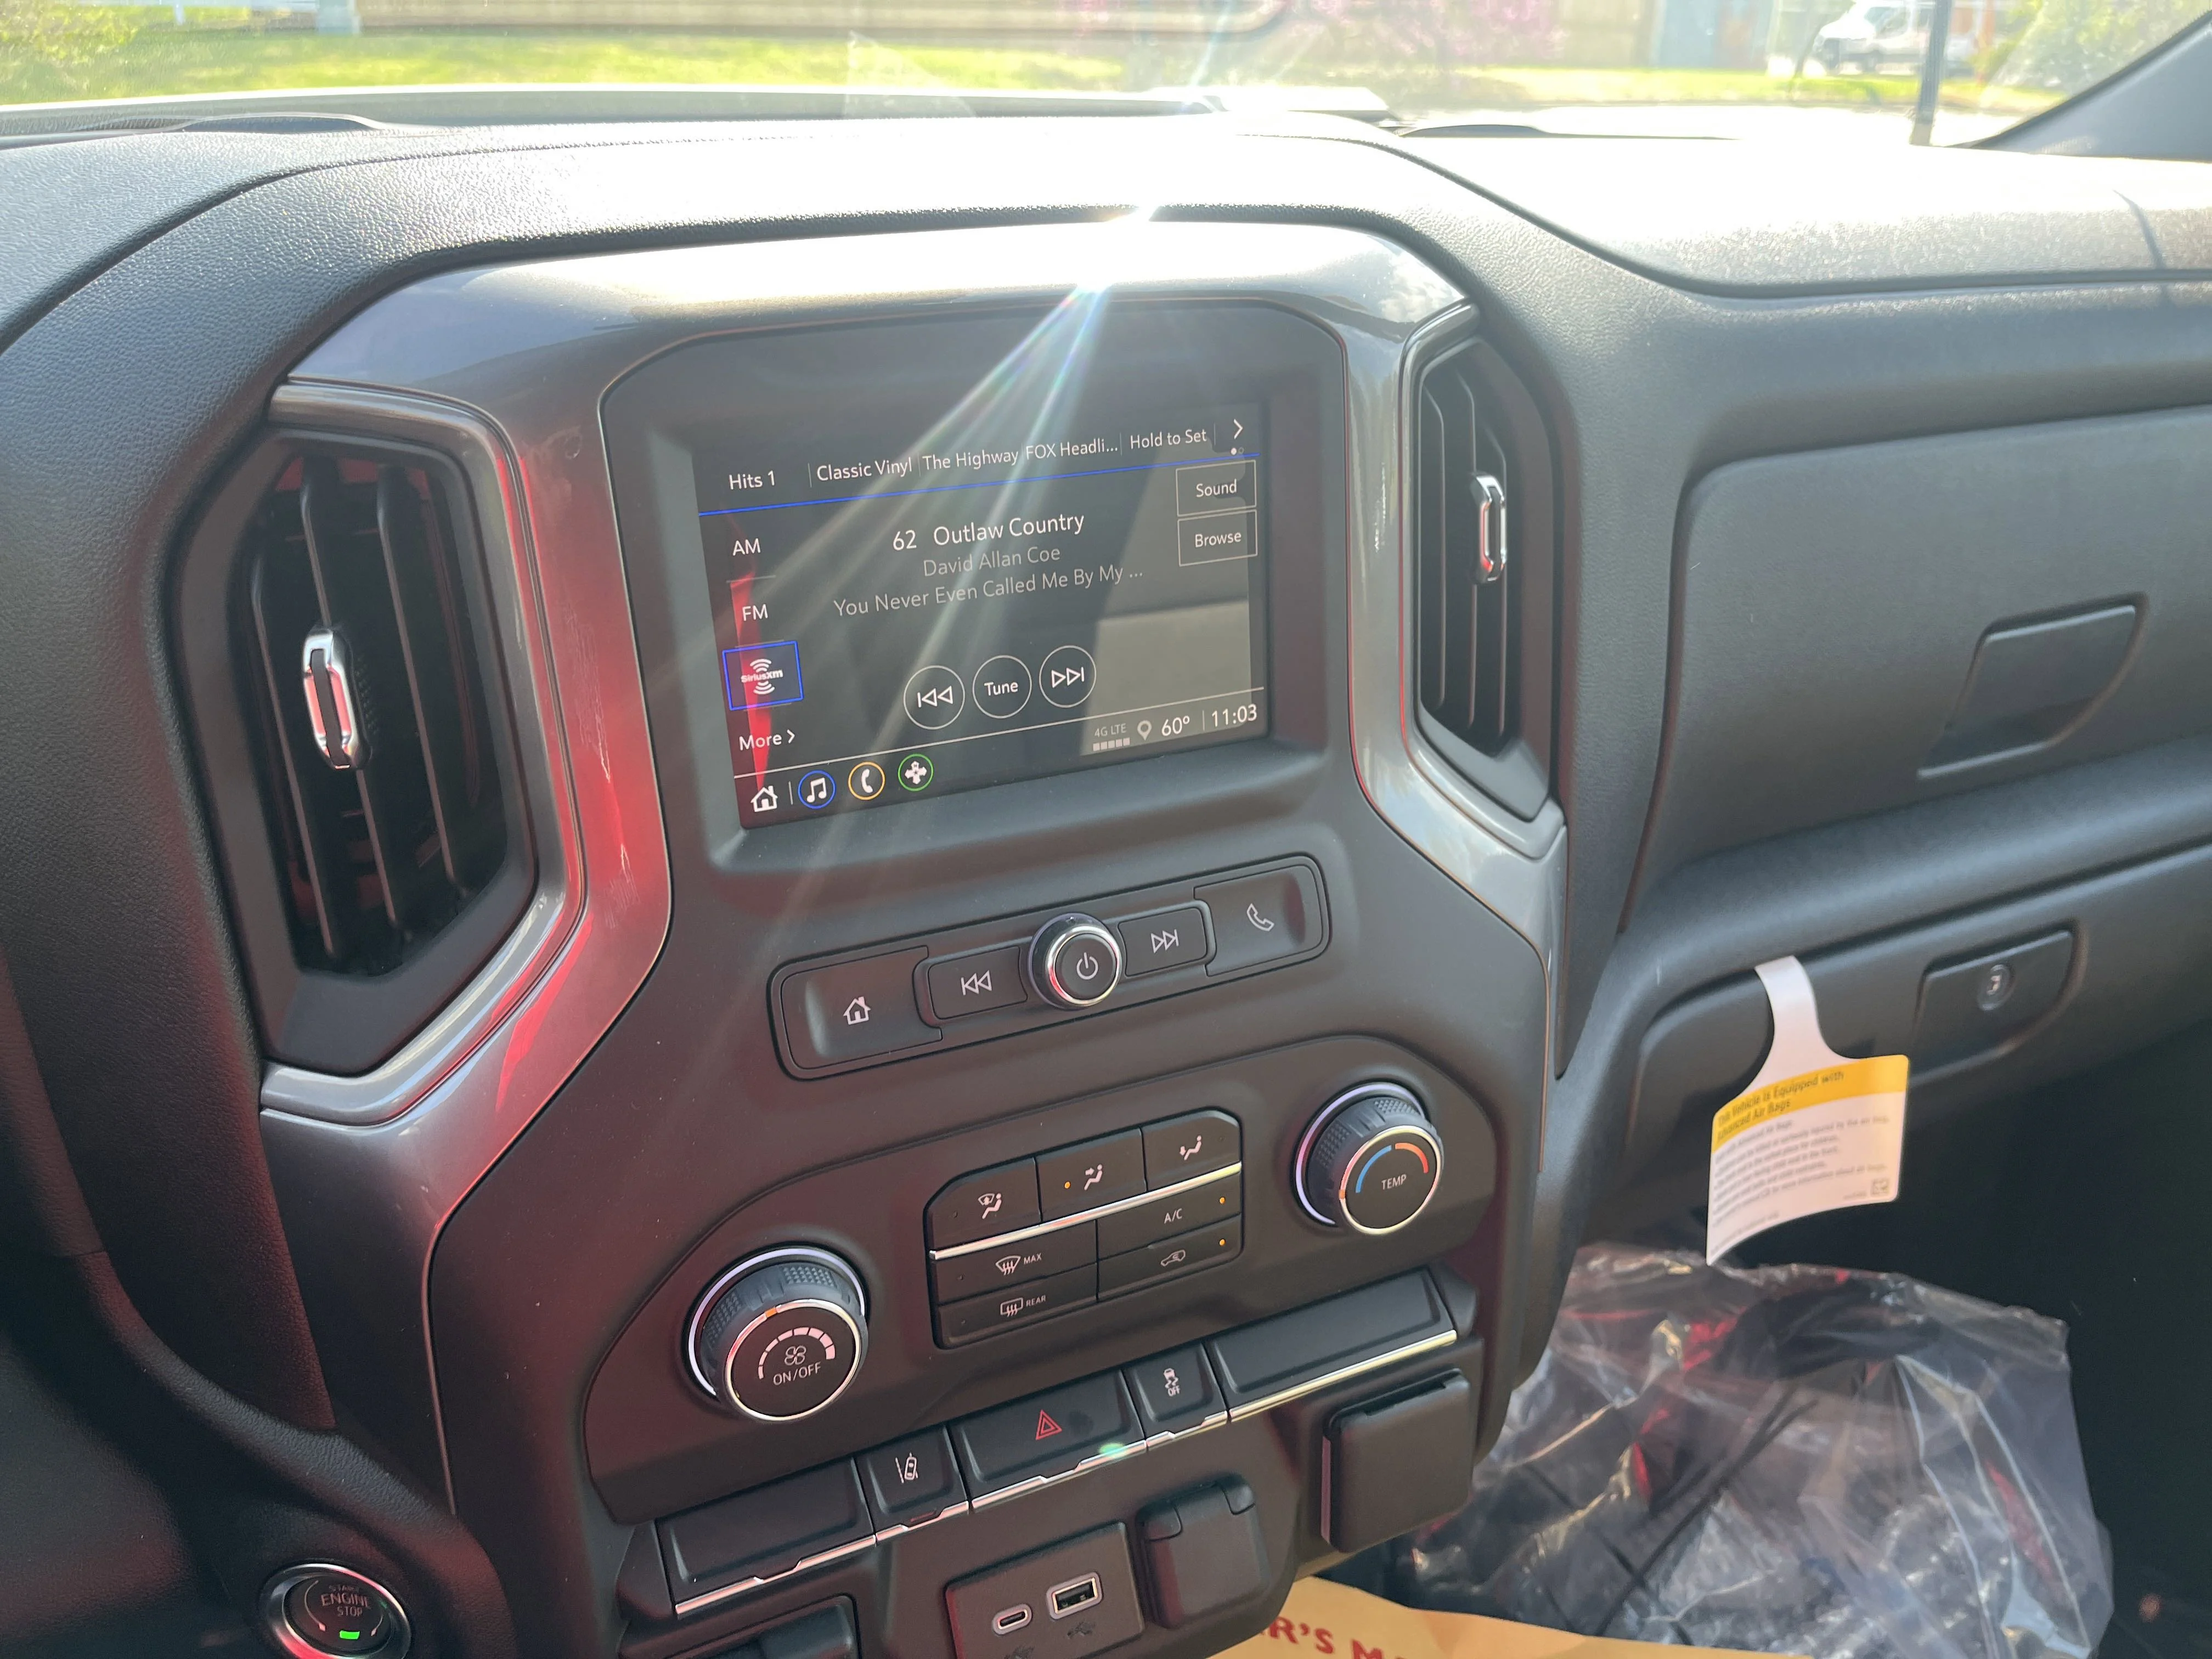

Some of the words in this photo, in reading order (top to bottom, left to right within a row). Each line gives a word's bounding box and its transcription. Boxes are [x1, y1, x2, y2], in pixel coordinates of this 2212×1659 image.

[1130, 432, 1163, 450] Hold
[1167, 432, 1181, 445] to
[1185, 428, 1207, 444] Set
[922, 454, 951, 470] The
[956, 449, 1019, 470] Highway
[1026, 444, 1057, 460] FOX
[816, 462, 872, 482] Classic
[874, 456, 912, 479] Vinyl
[729, 472, 763, 490] Hits
[768, 470, 776, 486] 1
[1196, 479, 1237, 498] Sound
[893, 529, 917, 551] 62
[933, 522, 1003, 546] Outlaw
[1009, 513, 1085, 537] Country
[1195, 531, 1242, 548] Browse
[732, 538, 761, 556] AM
[923, 554, 973, 577] David
[979, 549, 1022, 571] Allan
[1027, 546, 1060, 565] Coe
[834, 599, 869, 617] You
[875, 591, 929, 613] Never
[935, 585, 978, 604] Even
[983, 574, 1036, 597] Called
[1042, 571, 1068, 590] Me
[1074, 567, 1094, 589] By
[1099, 565, 1124, 584] My
[742, 604, 769, 622] FM
[984, 680, 1019, 696] Tune
[1212, 703, 1257, 728] 11:03
[1094, 727, 1108, 737] 4G
[1111, 723, 1127, 736] LTE
[739, 733, 782, 751] More
[1773, 1076, 1819, 1098] Equipped
[1822, 1071, 1844, 1084] with
[1768, 1100, 1791, 1115] Bags
[1381, 1174, 1407, 1190] TEMP
[1164, 1208, 1182, 1223] A/C
[1024, 1253, 1042, 1265] MAX
[1026, 1295, 1046, 1307] REAR
[773, 1361, 821, 1385] ON/OFF
[1167, 1385, 1180, 1397] OFF
[337, 1606, 363, 1617] STOP
[1260, 1616, 1335, 1655] R'S
